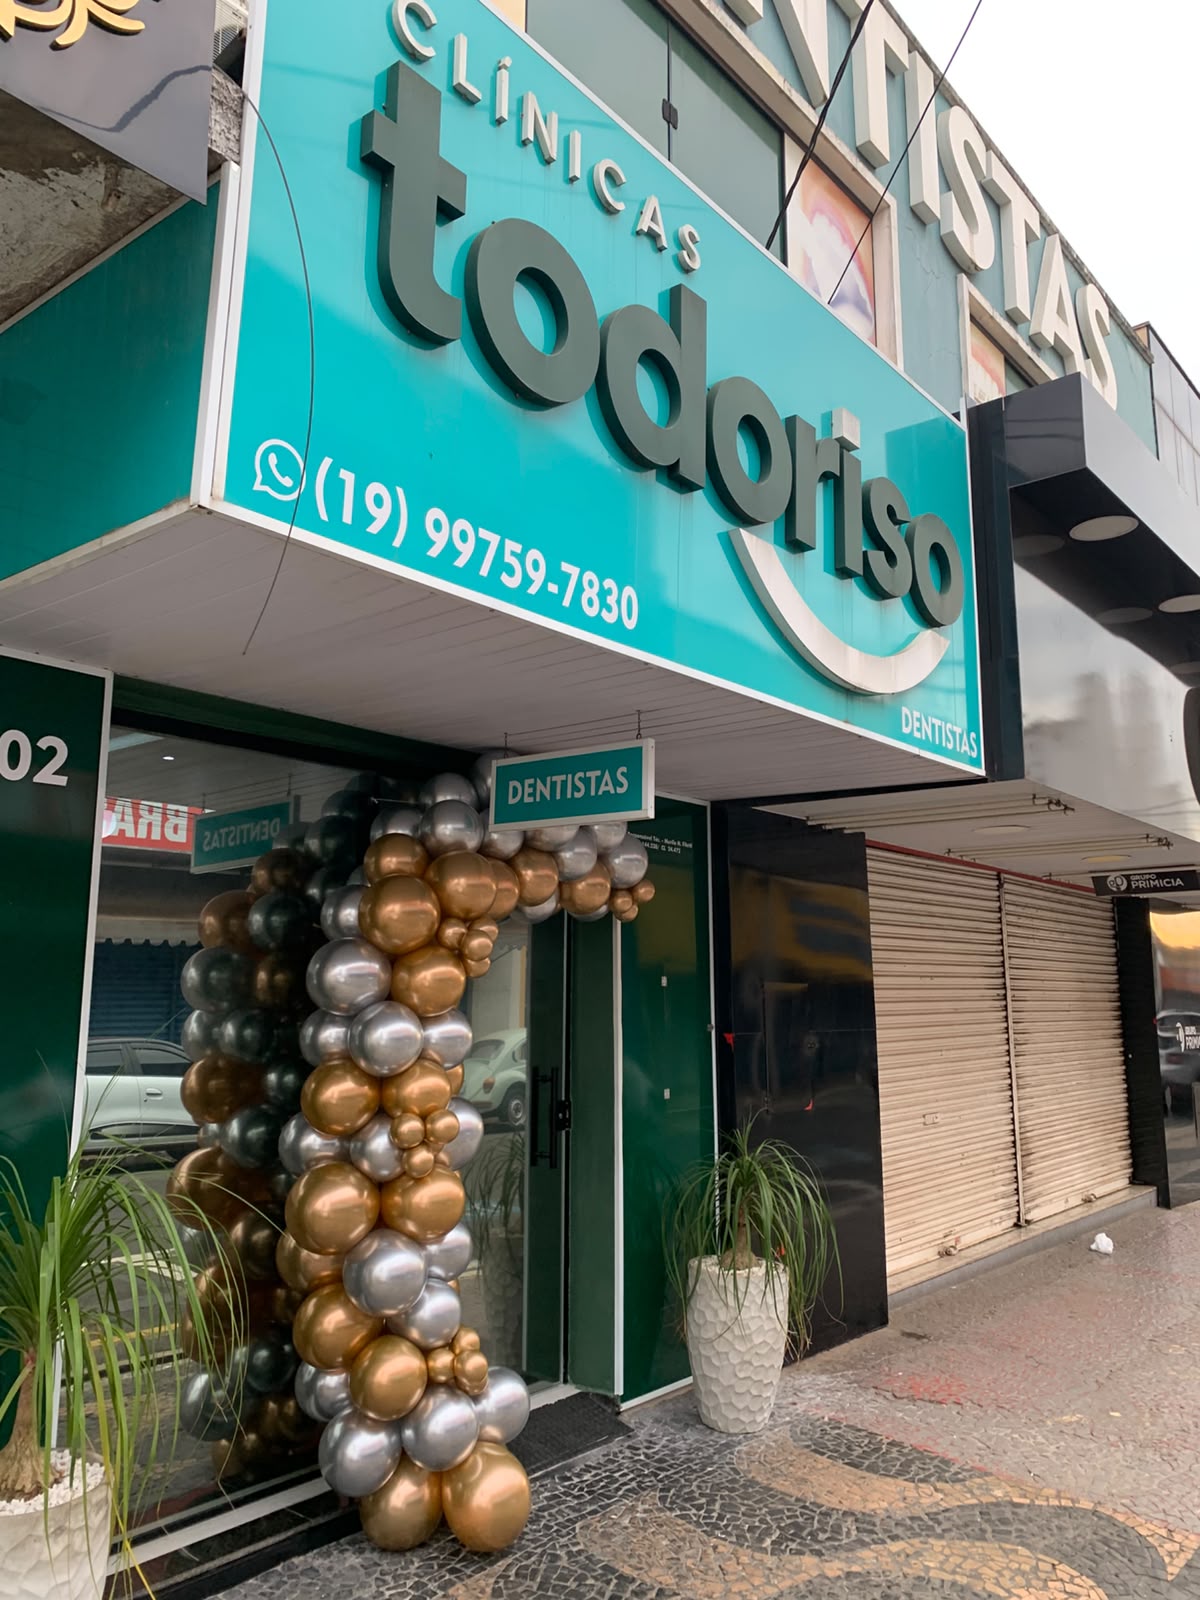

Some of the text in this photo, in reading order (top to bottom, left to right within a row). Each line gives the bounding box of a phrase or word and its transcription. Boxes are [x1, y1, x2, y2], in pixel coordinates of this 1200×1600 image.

[361, 60, 964, 627] todoriso
[315, 456, 638, 630] (19) 99759-7830
[901, 706, 978, 759] DENTISTAS
[508, 766, 629, 804] DENTISTAS
[1130, 878, 1185, 889] PRIMICIA
